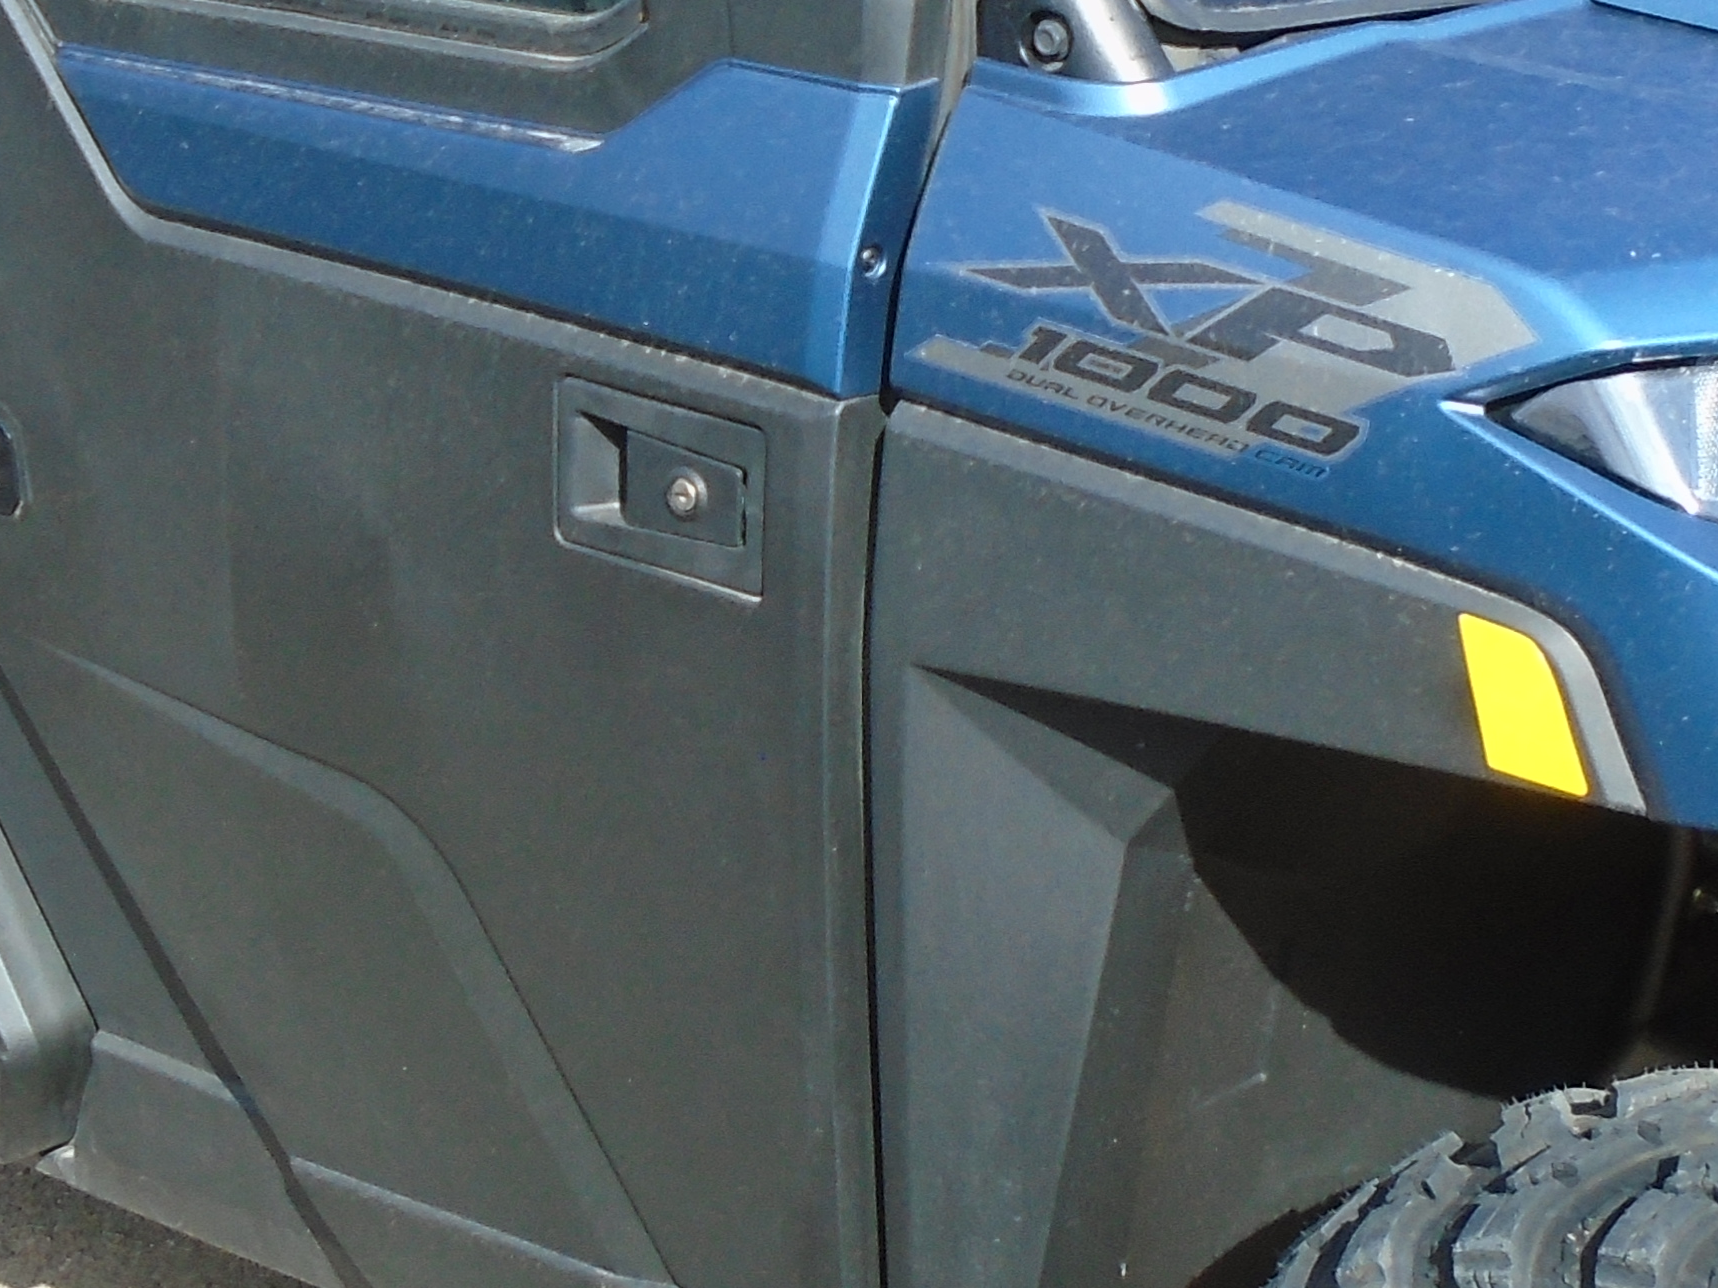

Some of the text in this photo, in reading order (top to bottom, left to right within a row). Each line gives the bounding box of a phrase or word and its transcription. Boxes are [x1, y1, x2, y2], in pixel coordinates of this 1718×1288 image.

[959, 209, 1457, 379] XP
[1005, 367, 1330, 479] DUAL OVERHEAD CAM
[1019, 323, 1364, 459] 1000
